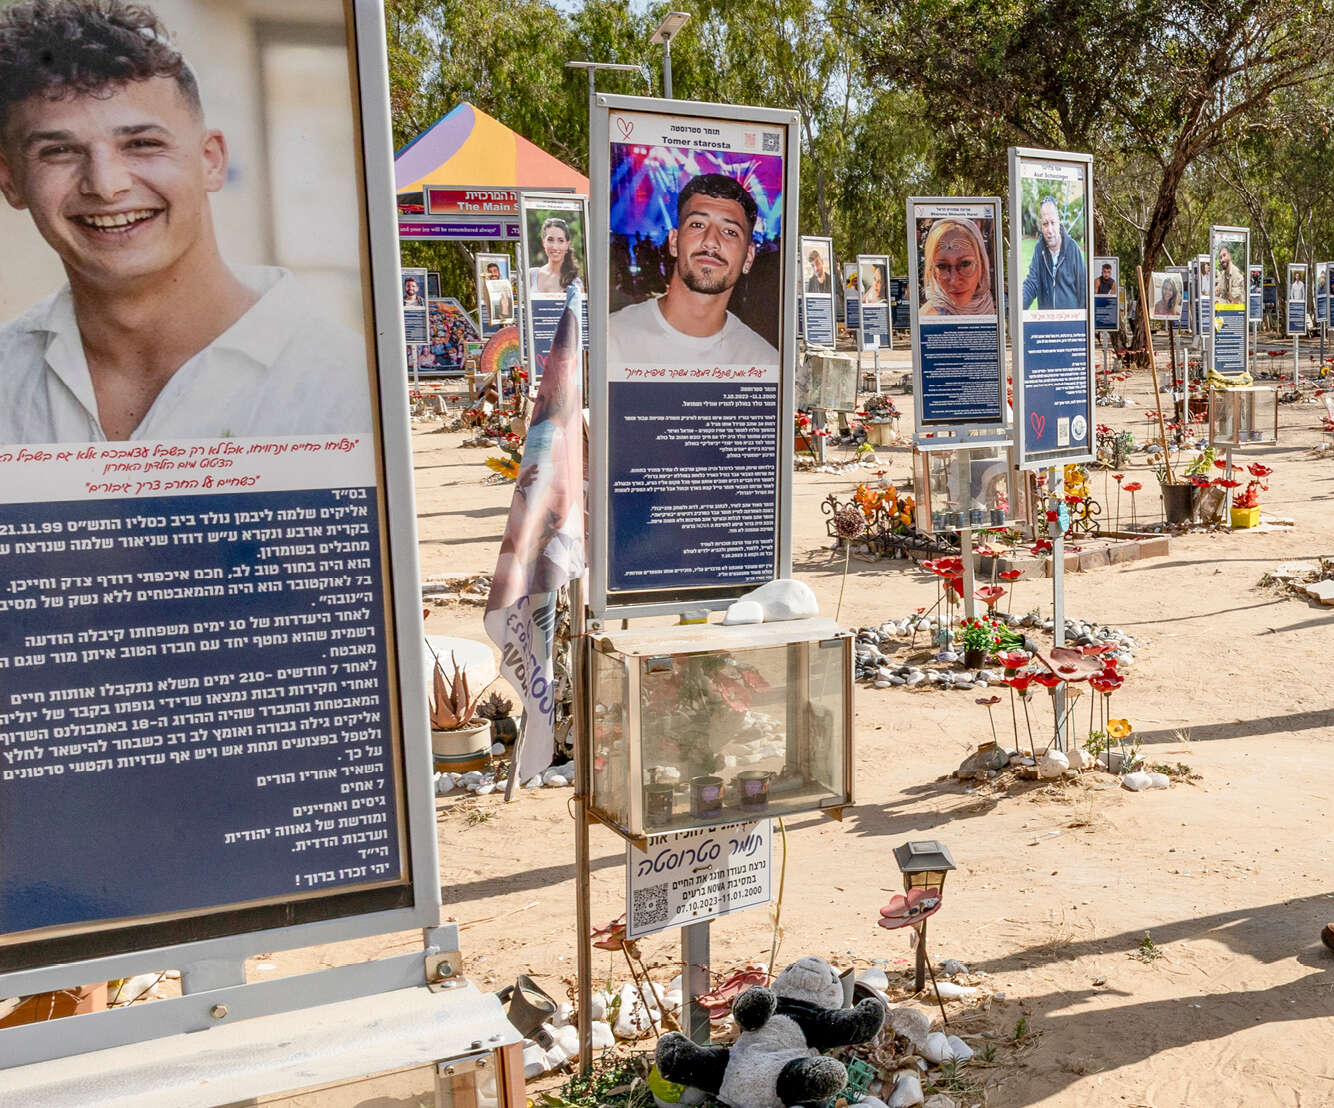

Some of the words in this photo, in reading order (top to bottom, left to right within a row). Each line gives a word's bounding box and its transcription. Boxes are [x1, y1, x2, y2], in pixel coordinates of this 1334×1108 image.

[670, 125, 701, 134] סטרוסטה
[662, 136, 691, 146] Tomer
[693, 140, 731, 149] starosta
[465, 190, 509, 201] המרכזית
[457, 202, 480, 212] The
[483, 202, 510, 212] Main
[152, 444, 186, 457] בשביל
[208, 442, 225, 456] לא
[224, 442, 244, 454] אבל
[291, 442, 322, 451] בחיים
[325, 438, 359, 451] "תצליחו
[16, 448, 52, 463] בשביל
[56, 452, 73, 461] גם
[76, 446, 97, 460] אלא
[189, 447, 205, 458] רק
[102, 463, 142, 475] האחרון
[145, 459, 175, 472] הולדתו
[177, 460, 197, 469] מיום
[200, 458, 232, 468] הציטוט
[86, 482, 132, 492] גיבורים"
[136, 480, 160, 494] צריך
[166, 480, 199, 489] החרב
[201, 475, 213, 488] על
[216, 475, 260, 486] "כשחיים
[199, 512, 230, 524] נולד
[234, 509, 273, 525] ליבמן
[277, 507, 316, 520] שלמה
[320, 504, 367, 519] אליקים
[125, 515, 166, 529] כסליו
[170, 515, 196, 526] ביב
[242, 528, 282, 541] ונקרא
[286, 526, 322, 538] ארבע
[326, 523, 369, 536] בקרית
[70, 536, 114, 551] שלמה
[118, 535, 168, 548] שניאור
[172, 533, 203, 544] דודו
[15, 541, 66, 554] שנרצח
[257, 544, 316, 559] בשומרון.
[319, 540, 370, 553] מחבלים
[254, 564, 279, 576] טוב
[283, 562, 316, 573] בחור
[319, 560, 343, 571] היה
[347, 558, 371, 569] הוא
[137, 570, 189, 582] איכפתי
[194, 568, 223, 579] חכם
[228, 564, 250, 579] לב,
[6, 578, 56, 593] וחייכן.
[60, 577, 92, 590] צדק
[97, 574, 133, 587] רודף
[258, 581, 282, 592] הוא
[286, 575, 352, 590] לאוקטובר
[137, 585, 224, 601] מהמאבטחים
[228, 583, 253, 594] היה
[41, 595, 64, 608] של
[68, 594, 98, 608] נשק
[103, 589, 132, 603] ללא
[345, 748, 362, 761] כך
[365, 745, 382, 757] על
[299, 768, 337, 781] אחריו
[341, 763, 383, 775] השאיר
[257, 773, 295, 787] הורים
[341, 780, 373, 793] אחים
[376, 779, 384, 789] 7
[293, 801, 347, 817] ואחיינים
[352, 796, 386, 809] גיסים
[315, 819, 334, 831] של
[338, 813, 386, 828] ומורשת
[224, 828, 271, 844] יהודית
[275, 823, 312, 837] גאווה
[342, 829, 388, 845] וערבות
[291, 836, 338, 852] הדדית.
[729, 834, 763, 857] תומר
[638, 839, 721, 877] סטרוסטה
[370, 863, 389, 874] יהי
[726, 865, 747, 878] בעודו
[749, 859, 766, 871] נרצח
[304, 871, 336, 886] ברוך
[339, 866, 367, 879] זכרו
[695, 873, 708, 884] את
[709, 869, 726, 881] חוגג
[672, 877, 695, 891] החיים
[707, 882, 726, 894] NOVA
[726, 874, 757, 890] במסיבת
[681, 886, 706, 901] ברעים
